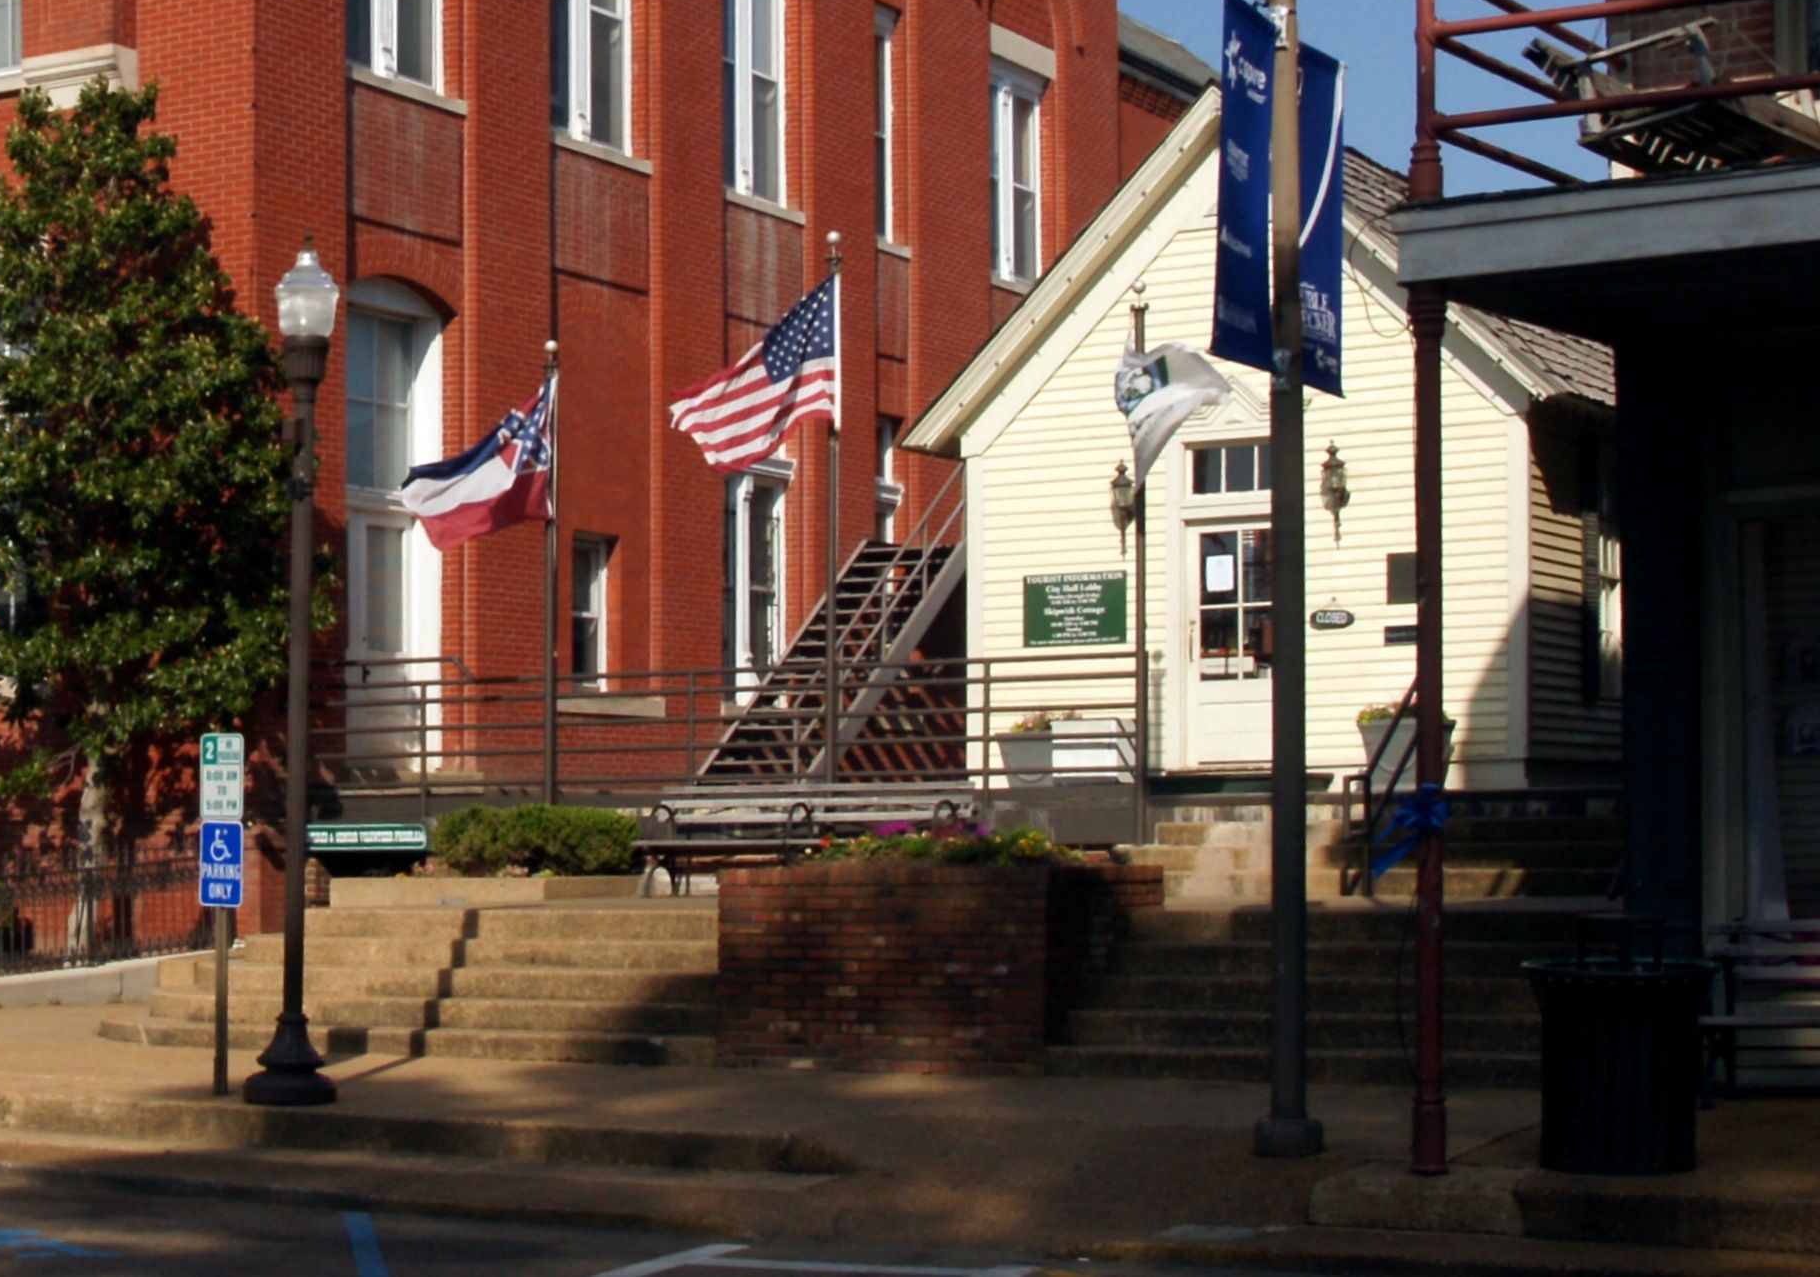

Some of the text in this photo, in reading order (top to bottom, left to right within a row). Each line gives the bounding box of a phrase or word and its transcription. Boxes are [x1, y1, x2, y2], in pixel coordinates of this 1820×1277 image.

[1027, 572, 1123, 584] TOURIST INFORMATION
[1045, 585, 1061, 596] City
[1062, 583, 1078, 592] Hall
[1076, 605, 1106, 616] Cottage
[1316, 611, 1348, 624] CLOSED
[205, 740, 215, 760] 2
[226, 770, 238, 781] AM
[216, 785, 227, 796] TO
[226, 800, 238, 811] PM
[202, 862, 241, 880] PARKING
[208, 882, 233, 899] ONLY
